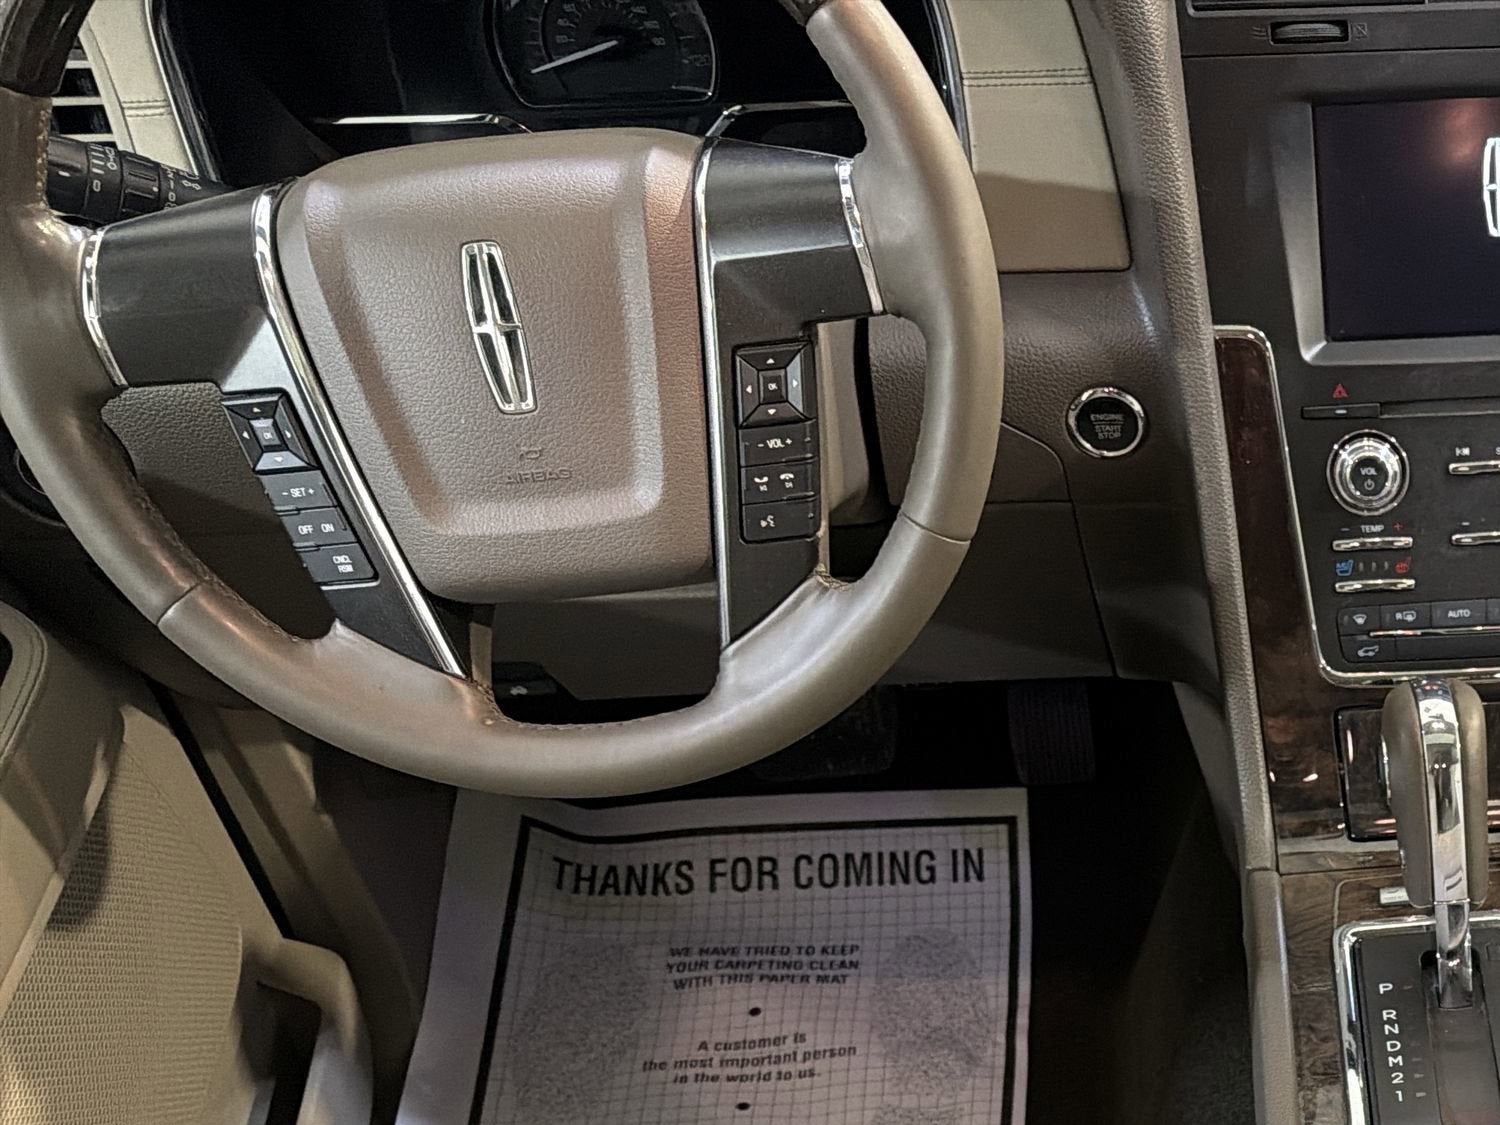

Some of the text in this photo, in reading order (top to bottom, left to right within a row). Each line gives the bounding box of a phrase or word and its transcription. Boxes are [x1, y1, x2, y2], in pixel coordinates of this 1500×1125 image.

[766, 438, 785, 449] VOL
[1360, 467, 1377, 476] VOL
[290, 487, 307, 498] SET
[297, 523, 335, 535] OFF ON
[1360, 524, 1385, 533] TEMP
[1447, 609, 1471, 618] AUTO
[552, 847, 986, 897] THANKS FOR COMING IN
[669, 944, 860, 957] WE HAVE TRIED TO KEEP
[666, 959, 860, 973] YOUR CARPETING CLEAN
[673, 973, 849, 990] WITH THIS PAPER MAT
[1378, 982, 1393, 995] P
[1382, 1009, 1397, 1021] R
[1384, 1024, 1399, 1035] N
[697, 1032, 807, 1052] A customer is
[1386, 1041, 1402, 1052] D
[642, 1045, 857, 1072] the most important person
[1388, 1056, 1404, 1067] M
[673, 1072, 688, 1084] in
[693, 1071, 720, 1083] the
[726, 1071, 771, 1083] world
[776, 1070, 792, 1081] to
[1391, 1072, 1405, 1084] 2
[1395, 1090, 1404, 1102] 1
